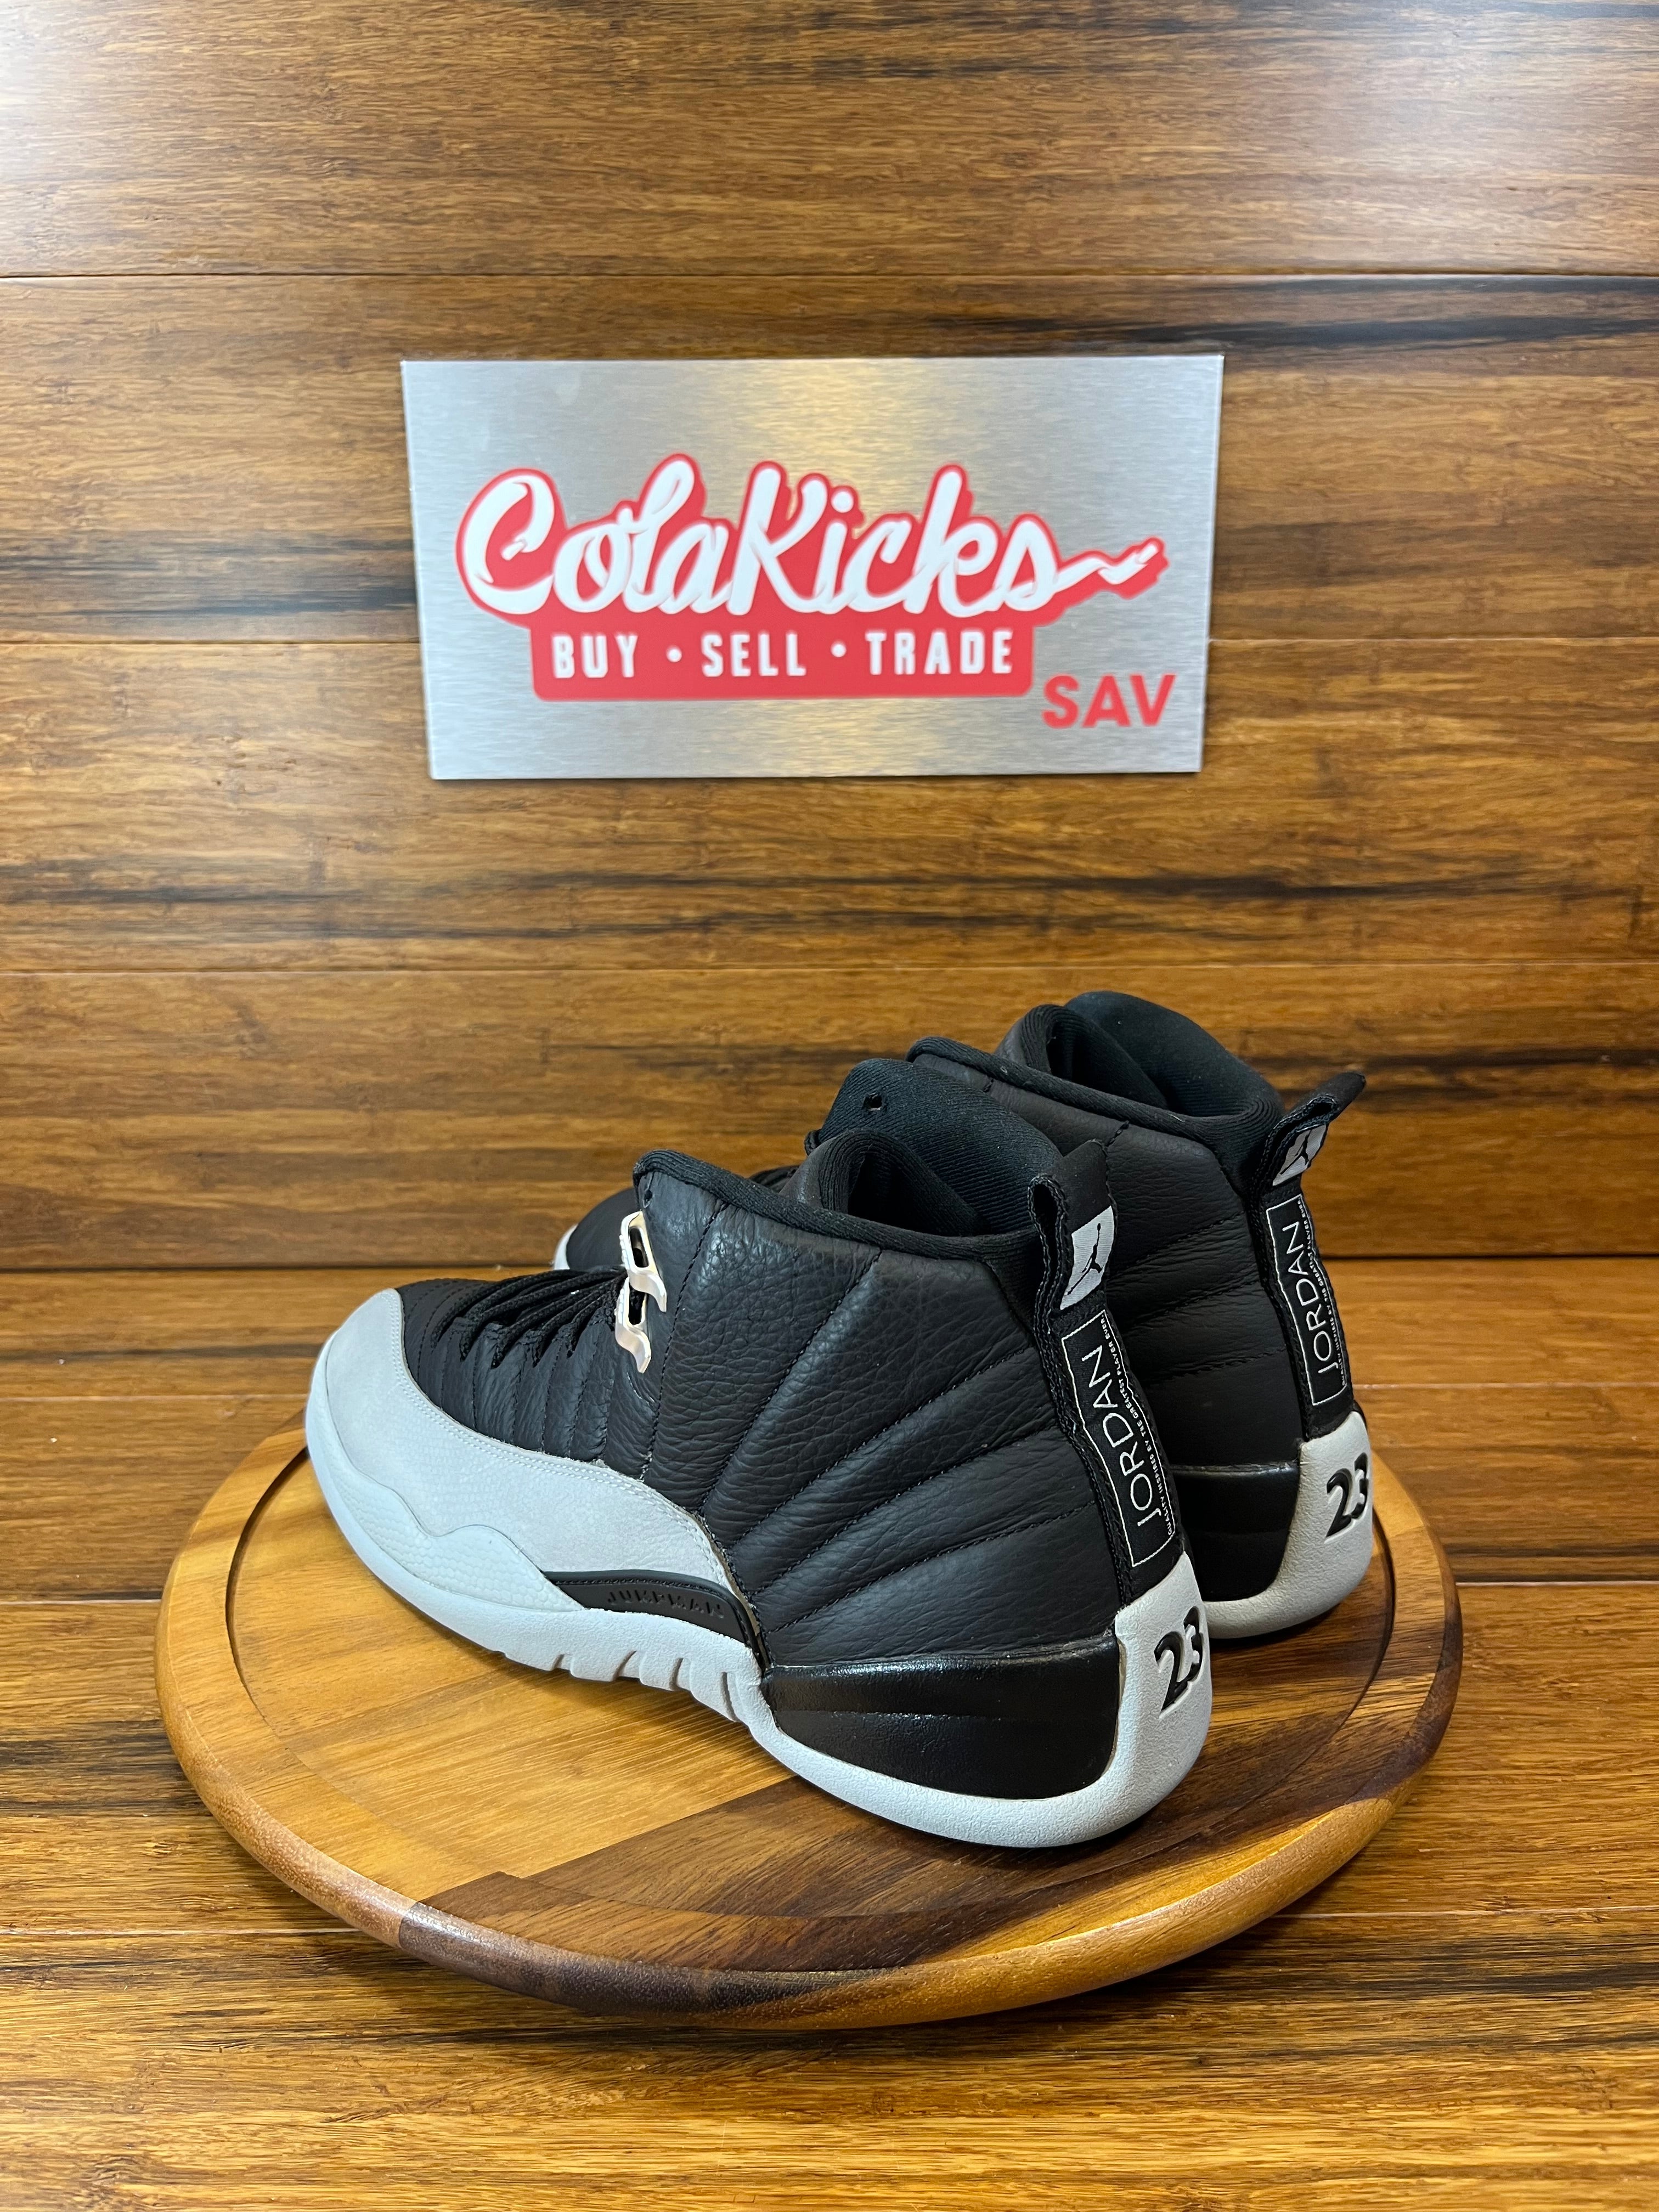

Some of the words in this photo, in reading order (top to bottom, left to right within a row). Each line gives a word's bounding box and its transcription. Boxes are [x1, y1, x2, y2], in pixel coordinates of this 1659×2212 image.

[460, 457, 1162, 618] ColaKicks
[552, 632, 639, 680] BUY
[702, 631, 806, 678] SELL
[865, 630, 1012, 675] TRADE
[1042, 674, 1176, 729] SAV
[1282, 1221, 1339, 1374] JORDAN
[1108, 1341, 1122, 1376] PLAYER
[1118, 1378, 1139, 1419] GREATEST
[1082, 1345, 1162, 1527] JORDAN
[1136, 1419, 1147, 1437] THE
[1144, 1440, 1152, 1452] BY
[1160, 1496, 1172, 1536] QUALITY
[1325, 1452, 1369, 1538] 23
[1153, 1606, 1204, 1711] 23
